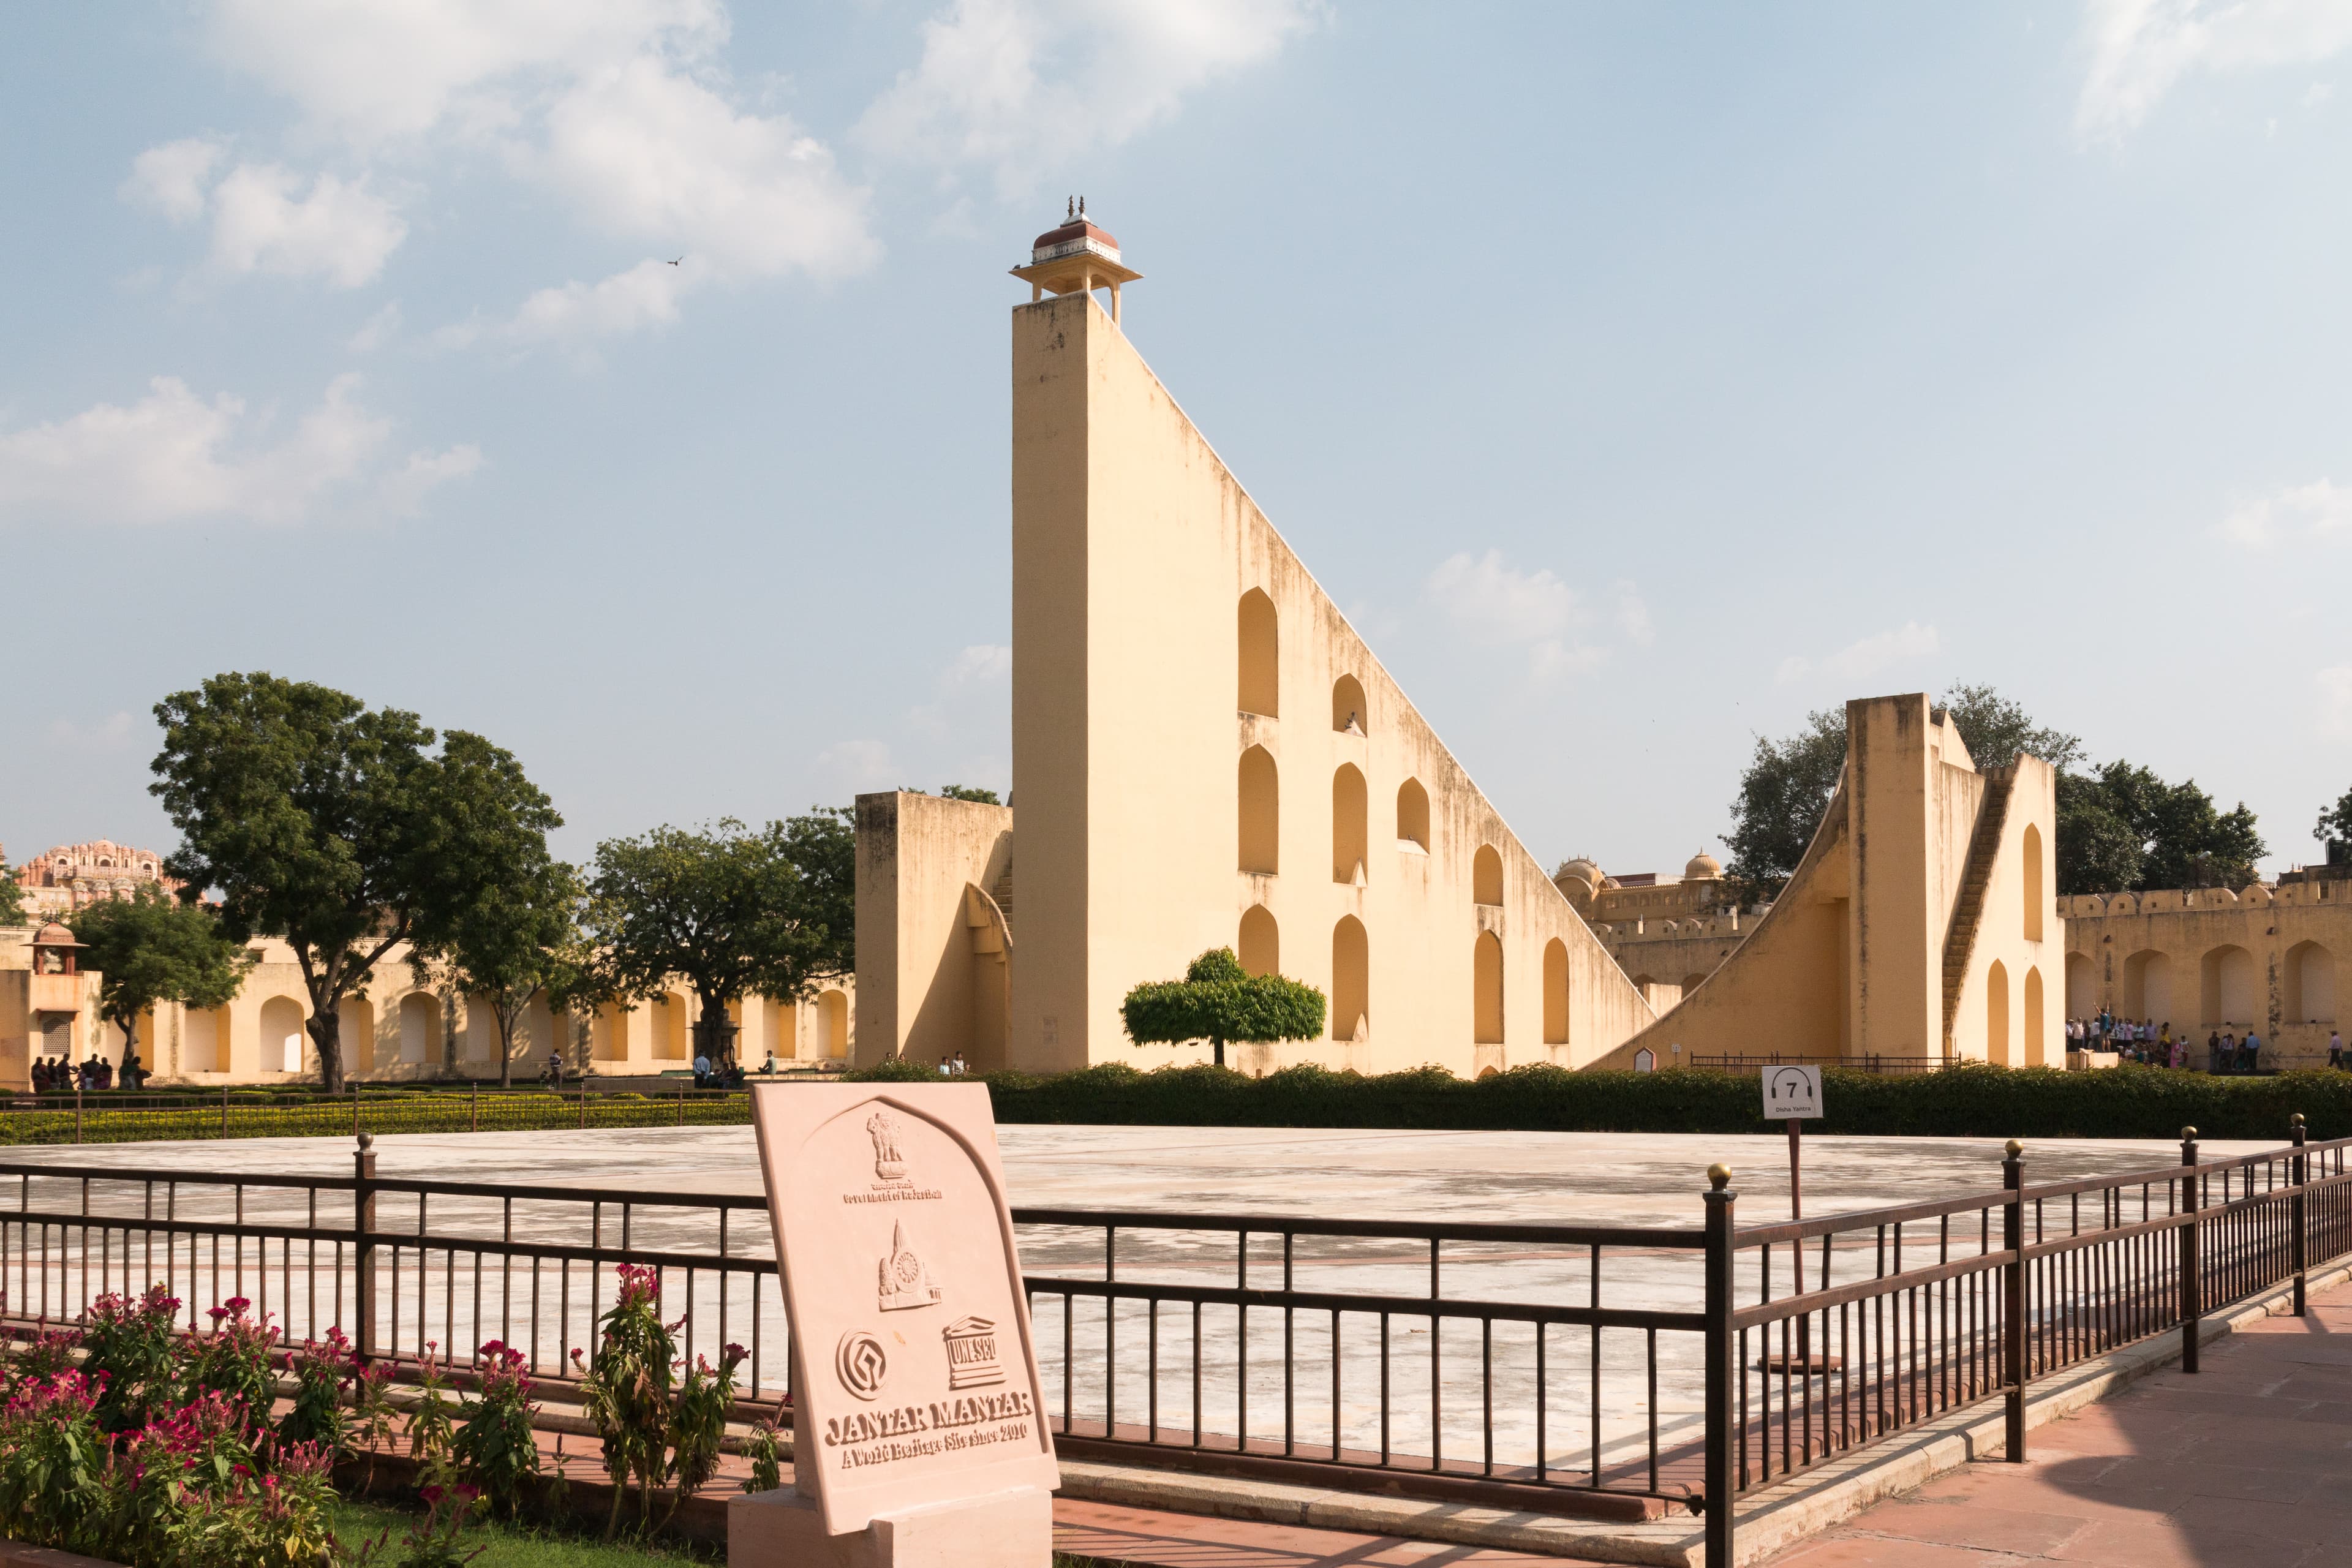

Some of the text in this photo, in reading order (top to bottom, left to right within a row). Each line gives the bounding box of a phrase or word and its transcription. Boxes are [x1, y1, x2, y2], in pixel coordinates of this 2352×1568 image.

[1786, 1082, 1797, 1098] 7
[843, 1190, 892, 1204] Government
[892, 1191, 900, 1201] of
[949, 1337, 997, 1365] UNESCO
[824, 1391, 1035, 1447] JANTAR MANTAR
[841, 1422, 1028, 1469] A World Heritage Site since 2010
